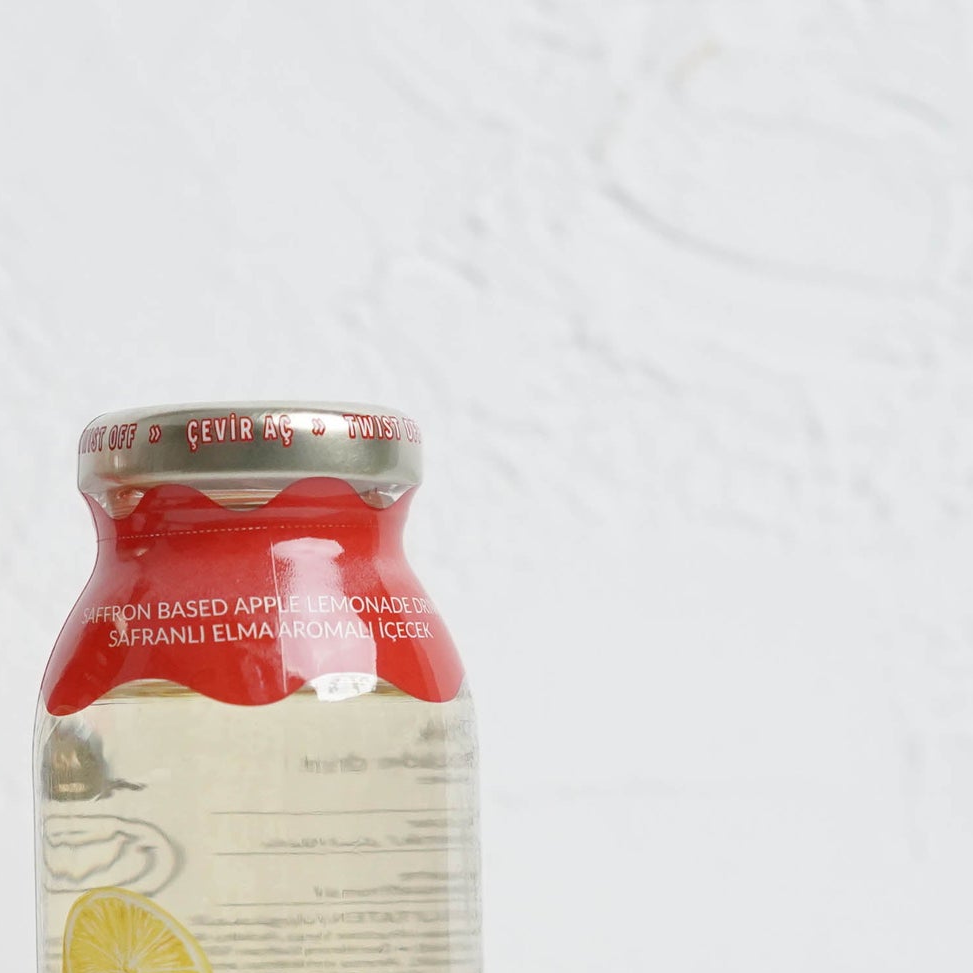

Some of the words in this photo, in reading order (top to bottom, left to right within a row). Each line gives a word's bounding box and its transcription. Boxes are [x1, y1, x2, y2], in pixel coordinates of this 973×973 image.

[108, 423, 138, 451] OFF
[187, 412, 254, 453] ÇEVİR
[263, 414, 294, 448] AÇ
[341, 413, 401, 441] TWIST
[82, 603, 152, 625] SAFFRON
[158, 598, 228, 620] BASED
[234, 595, 301, 616] APPLE
[307, 595, 413, 615] LEMONADE
[108, 625, 205, 648] SAFRANLI
[212, 621, 274, 643] ELMA
[278, 619, 375, 640] AROMALI
[378, 617, 435, 642] İÇECEK
